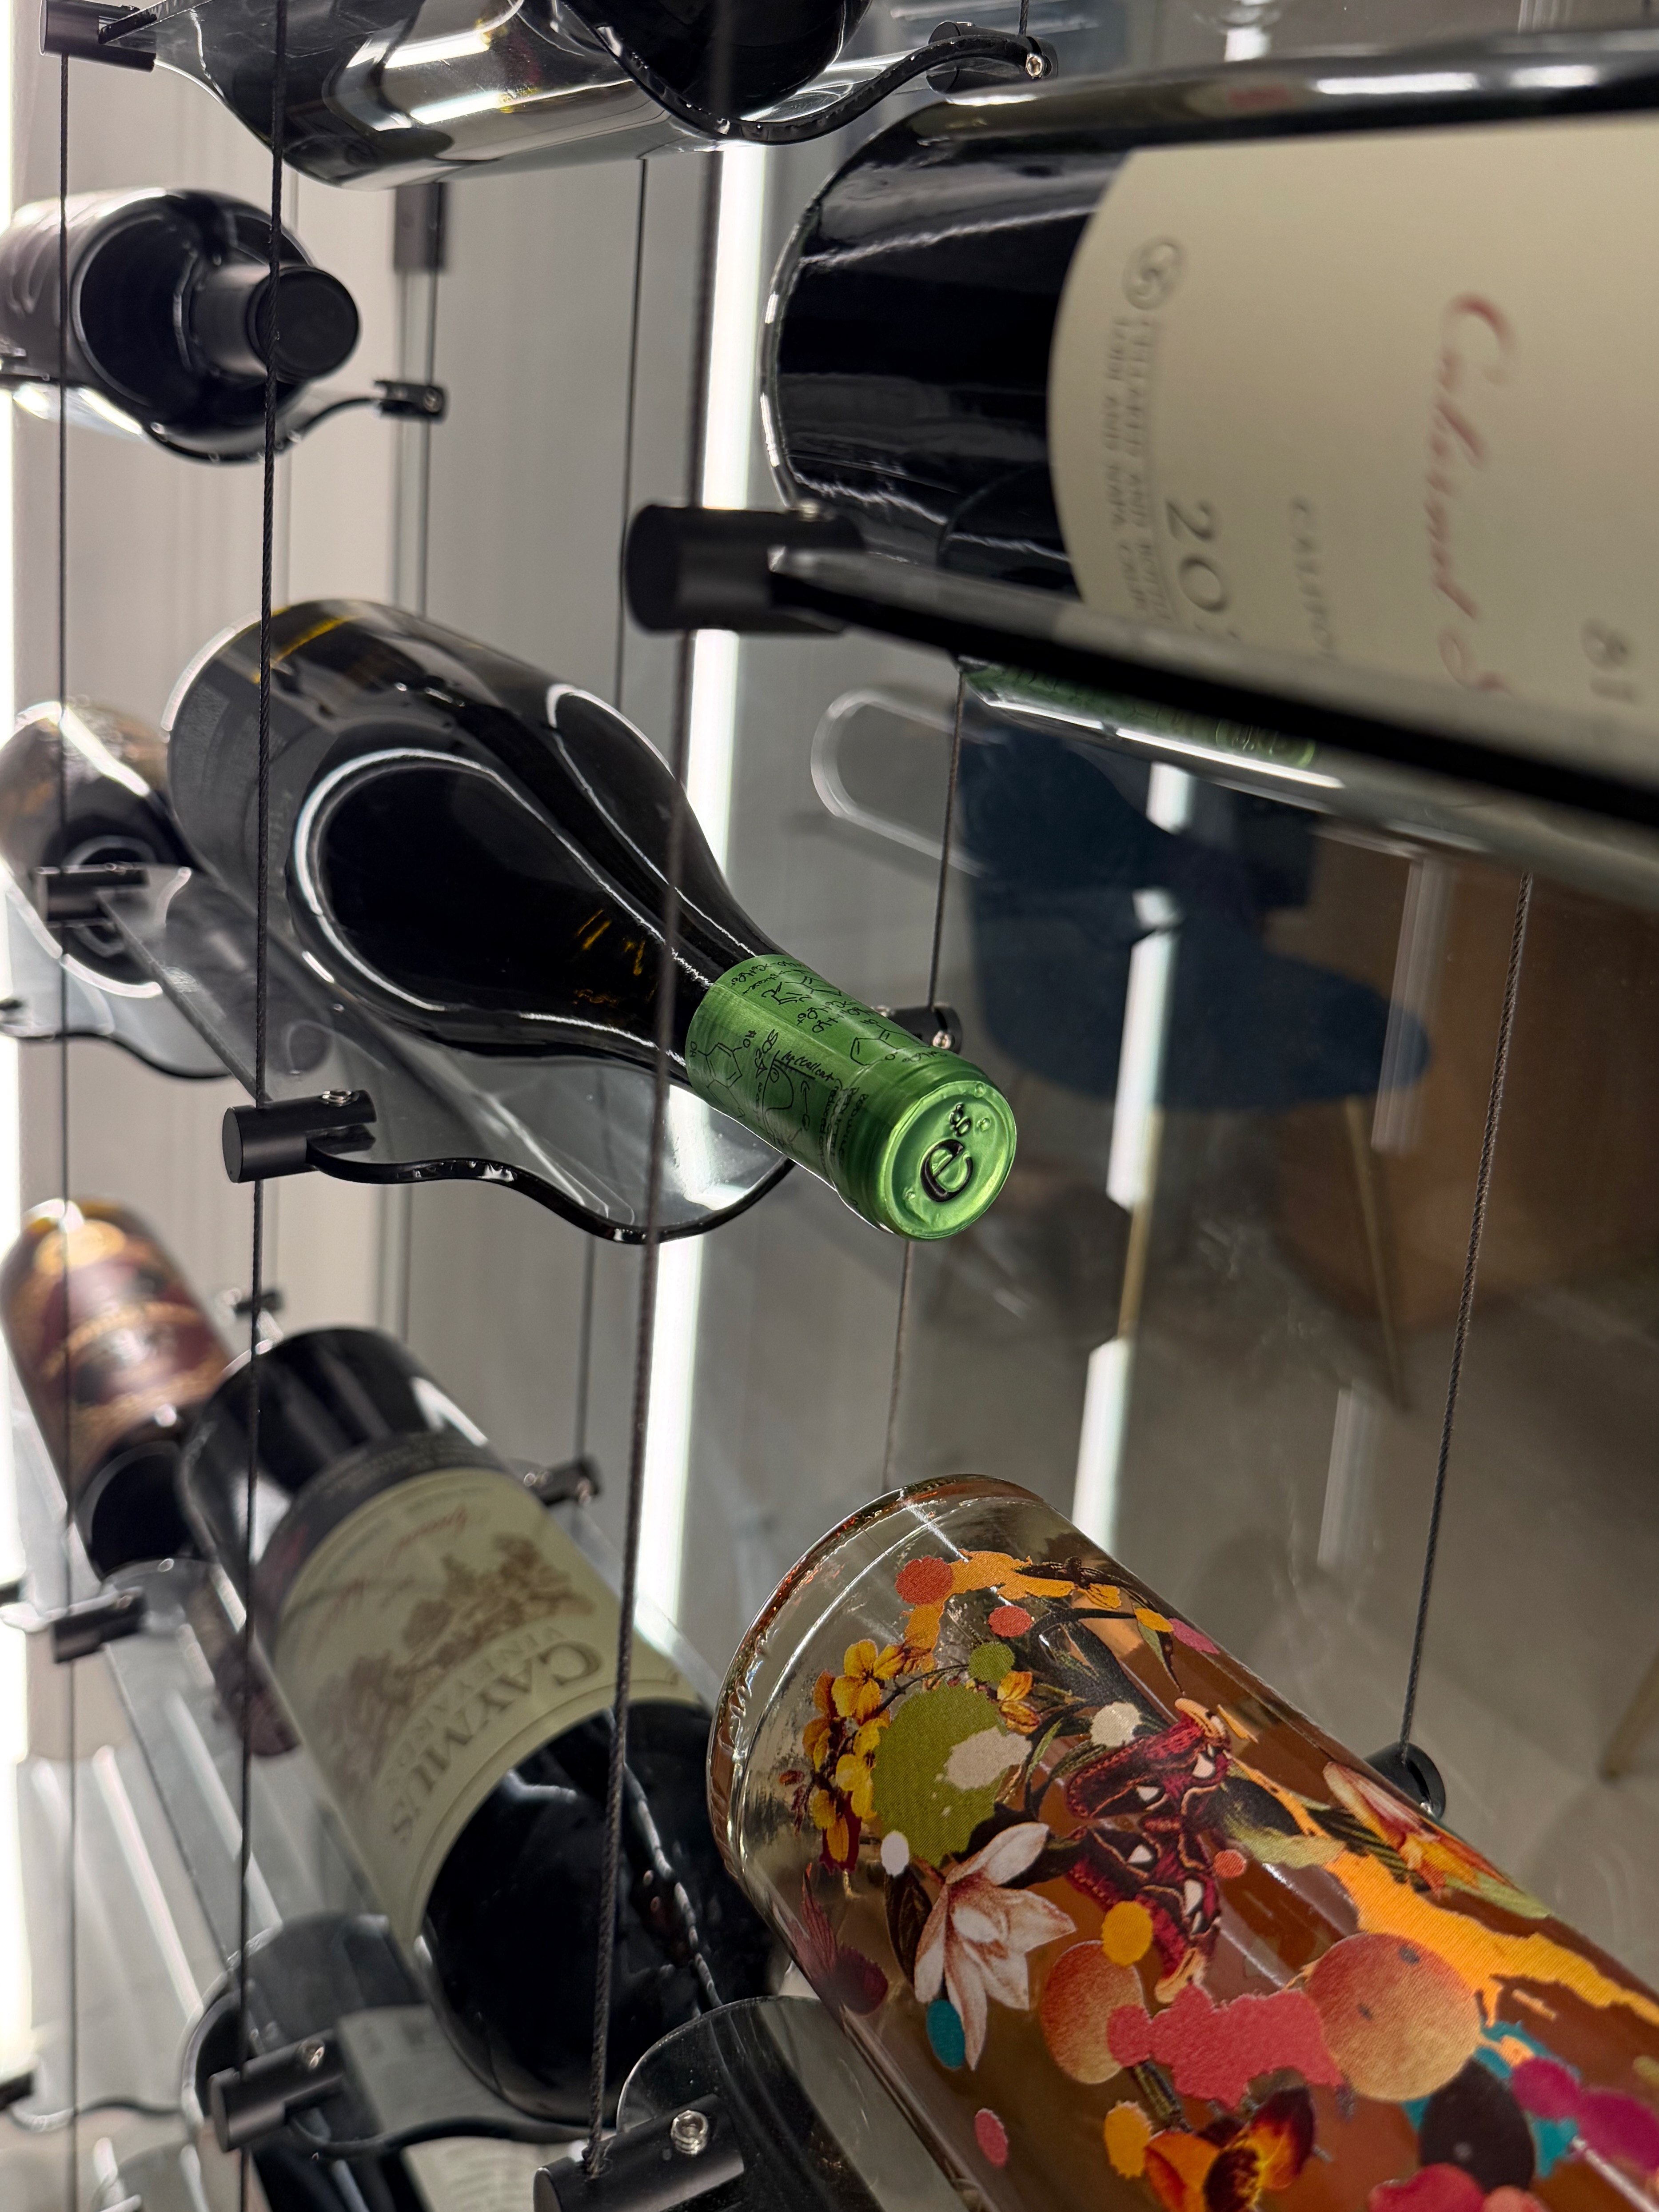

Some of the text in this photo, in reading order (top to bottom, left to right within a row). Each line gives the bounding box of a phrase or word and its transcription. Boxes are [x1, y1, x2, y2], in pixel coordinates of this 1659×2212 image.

[1106, 316, 1132, 381] LODI
[1103, 395, 1125, 451] AND
[1424, 291, 1516, 620] Cabernet
[1129, 473, 1149, 529] AND
[1162, 498, 1238, 640] 20
[391, 1640, 604, 1846] CAYMUS
